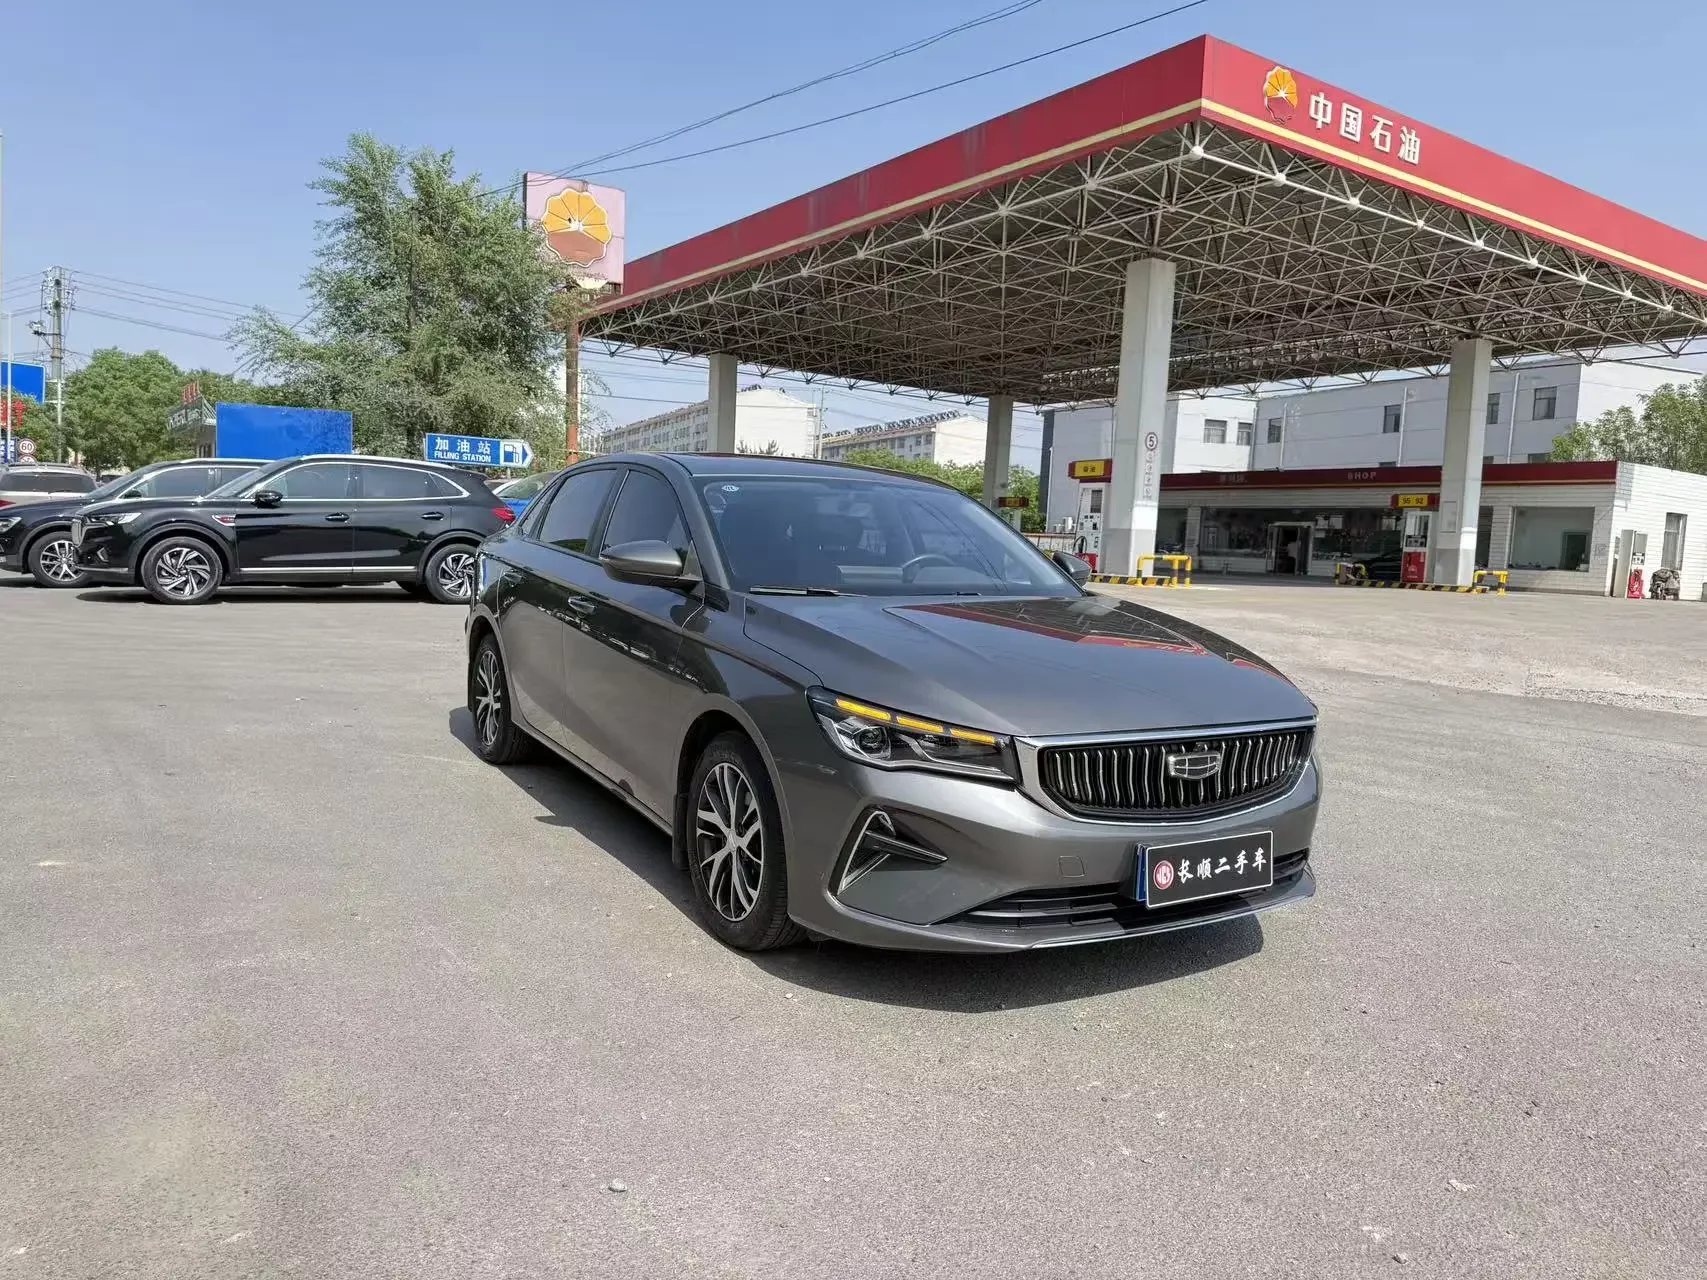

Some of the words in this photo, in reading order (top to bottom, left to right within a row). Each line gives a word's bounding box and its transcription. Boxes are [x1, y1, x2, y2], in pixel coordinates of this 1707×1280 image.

[1309, 91, 1421, 165] 中国石油
[21, 442, 33, 451] 60
[435, 437, 491, 455] 加油站
[1148, 435, 1155, 448] 5
[434, 450, 460, 460] FILLING
[462, 452, 491, 463] STATION
[1177, 847, 1267, 884] 长顺二手车
